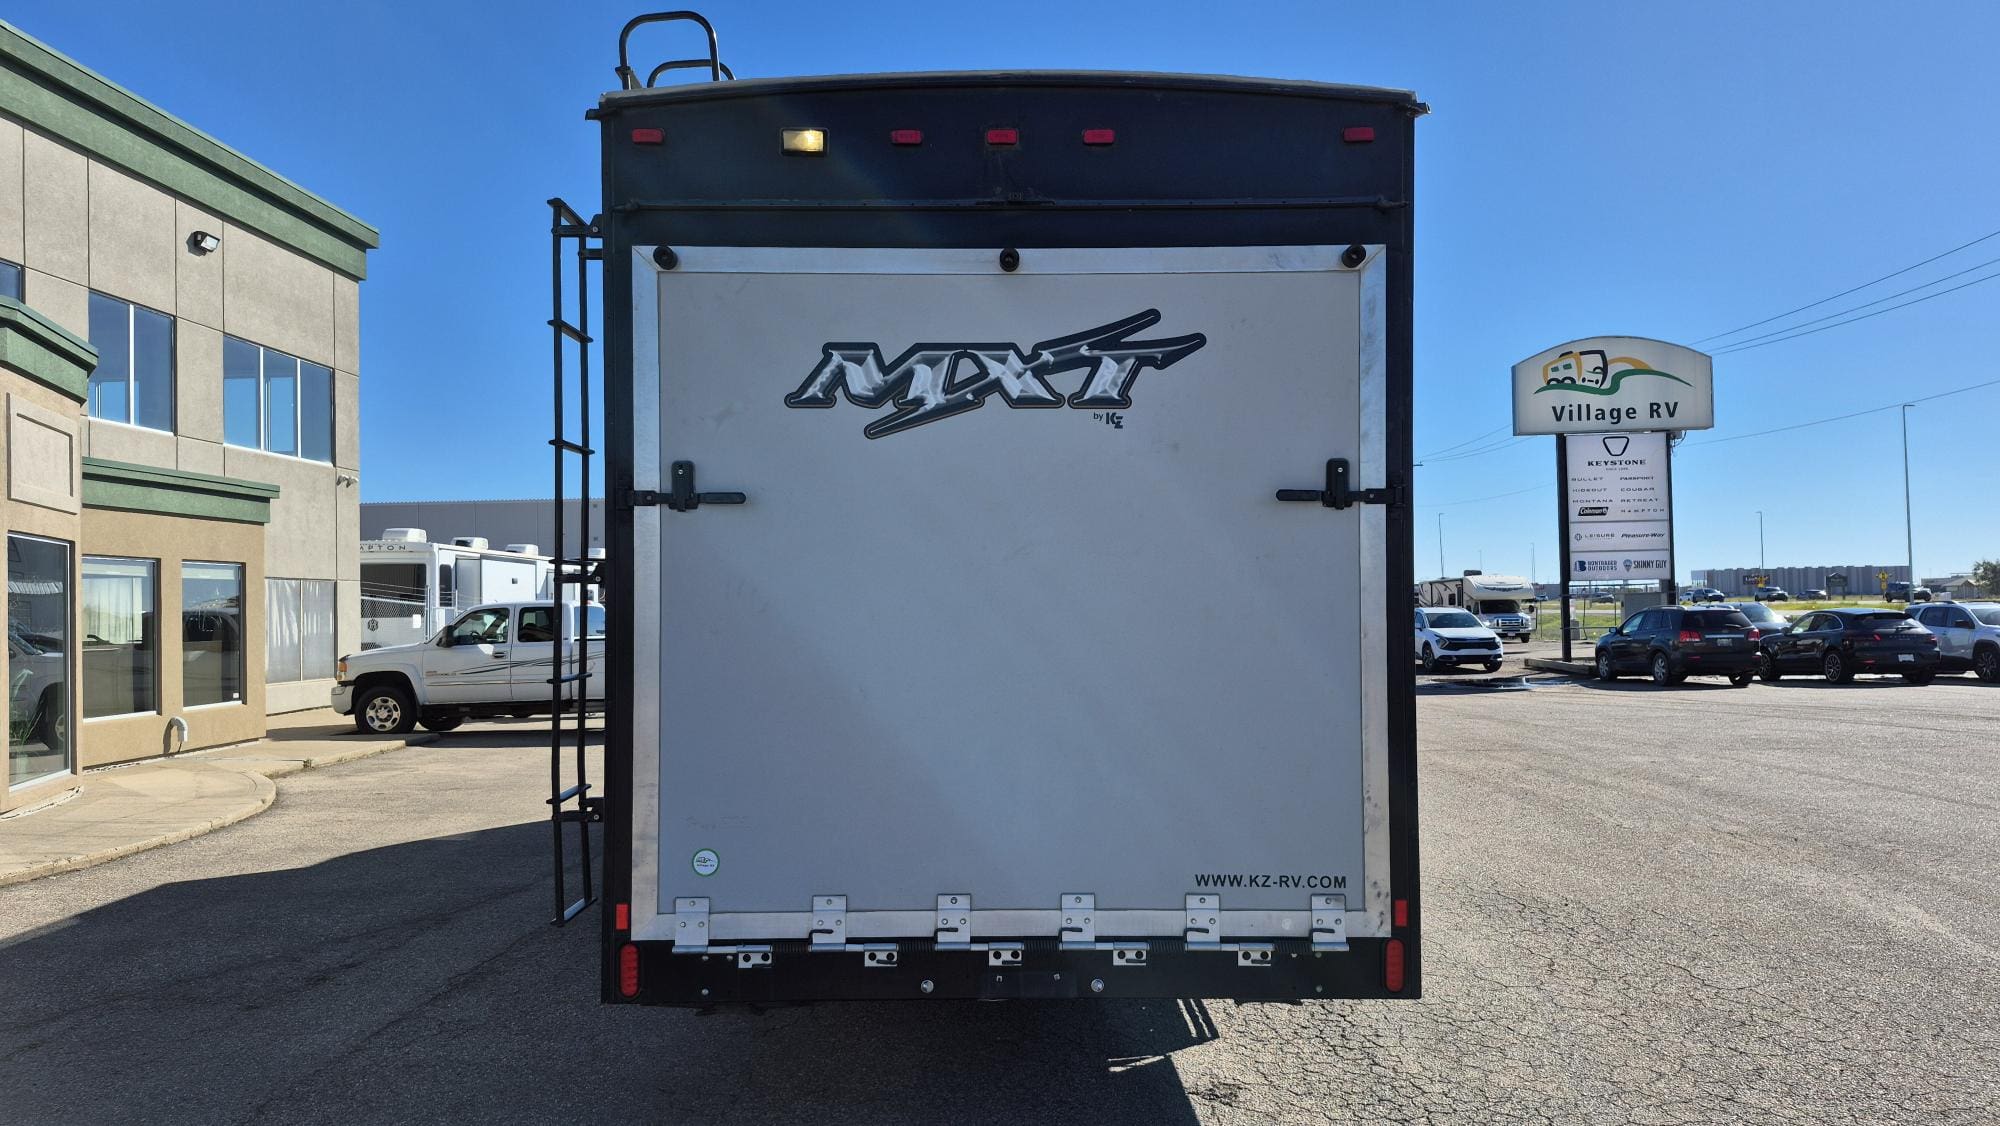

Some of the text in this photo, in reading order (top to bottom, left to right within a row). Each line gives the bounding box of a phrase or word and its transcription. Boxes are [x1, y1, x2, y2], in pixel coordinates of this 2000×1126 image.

[1093, 411, 1104, 422] by
[1551, 401, 1679, 425] Village RV
[1587, 459, 1646, 467] KEYSTONE
[1633, 559, 1667, 569] SKINNY GUY
[1195, 873, 1347, 889] WWW.KZ-RV.COM
